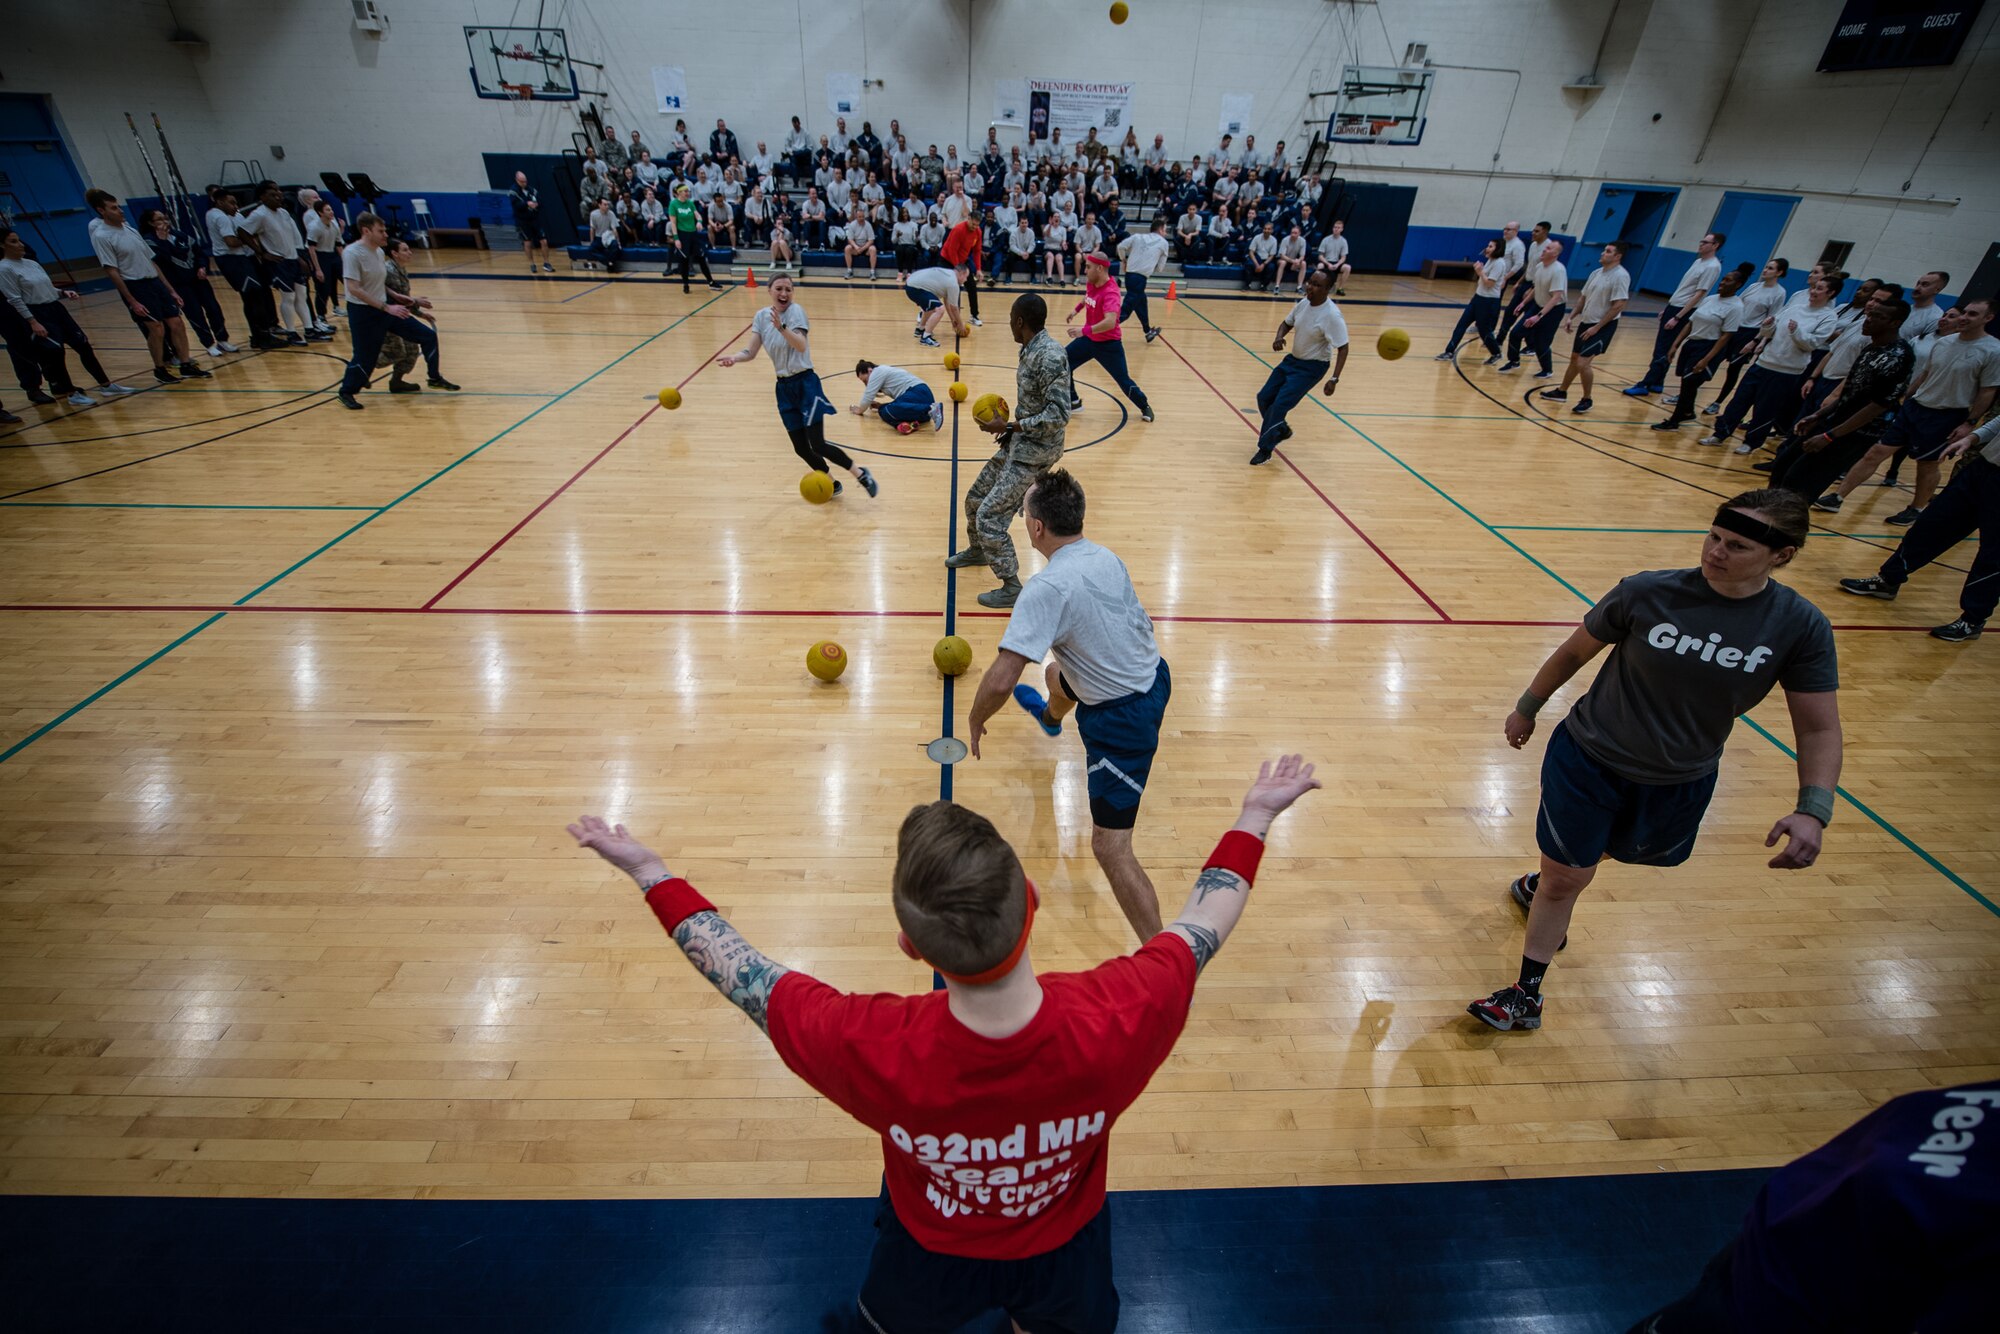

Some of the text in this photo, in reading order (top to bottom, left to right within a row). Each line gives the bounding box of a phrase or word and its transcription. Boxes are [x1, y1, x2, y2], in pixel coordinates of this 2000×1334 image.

[1922, 12, 1961, 28] GUEST
[1838, 22, 1867, 36] HOME
[1881, 25, 1906, 36] PERIOD
[1030, 81, 1130, 94] DEFENDERS GATEWAY
[1648, 622, 1773, 673] Grief
[1039, 1111, 1106, 1154] MH
